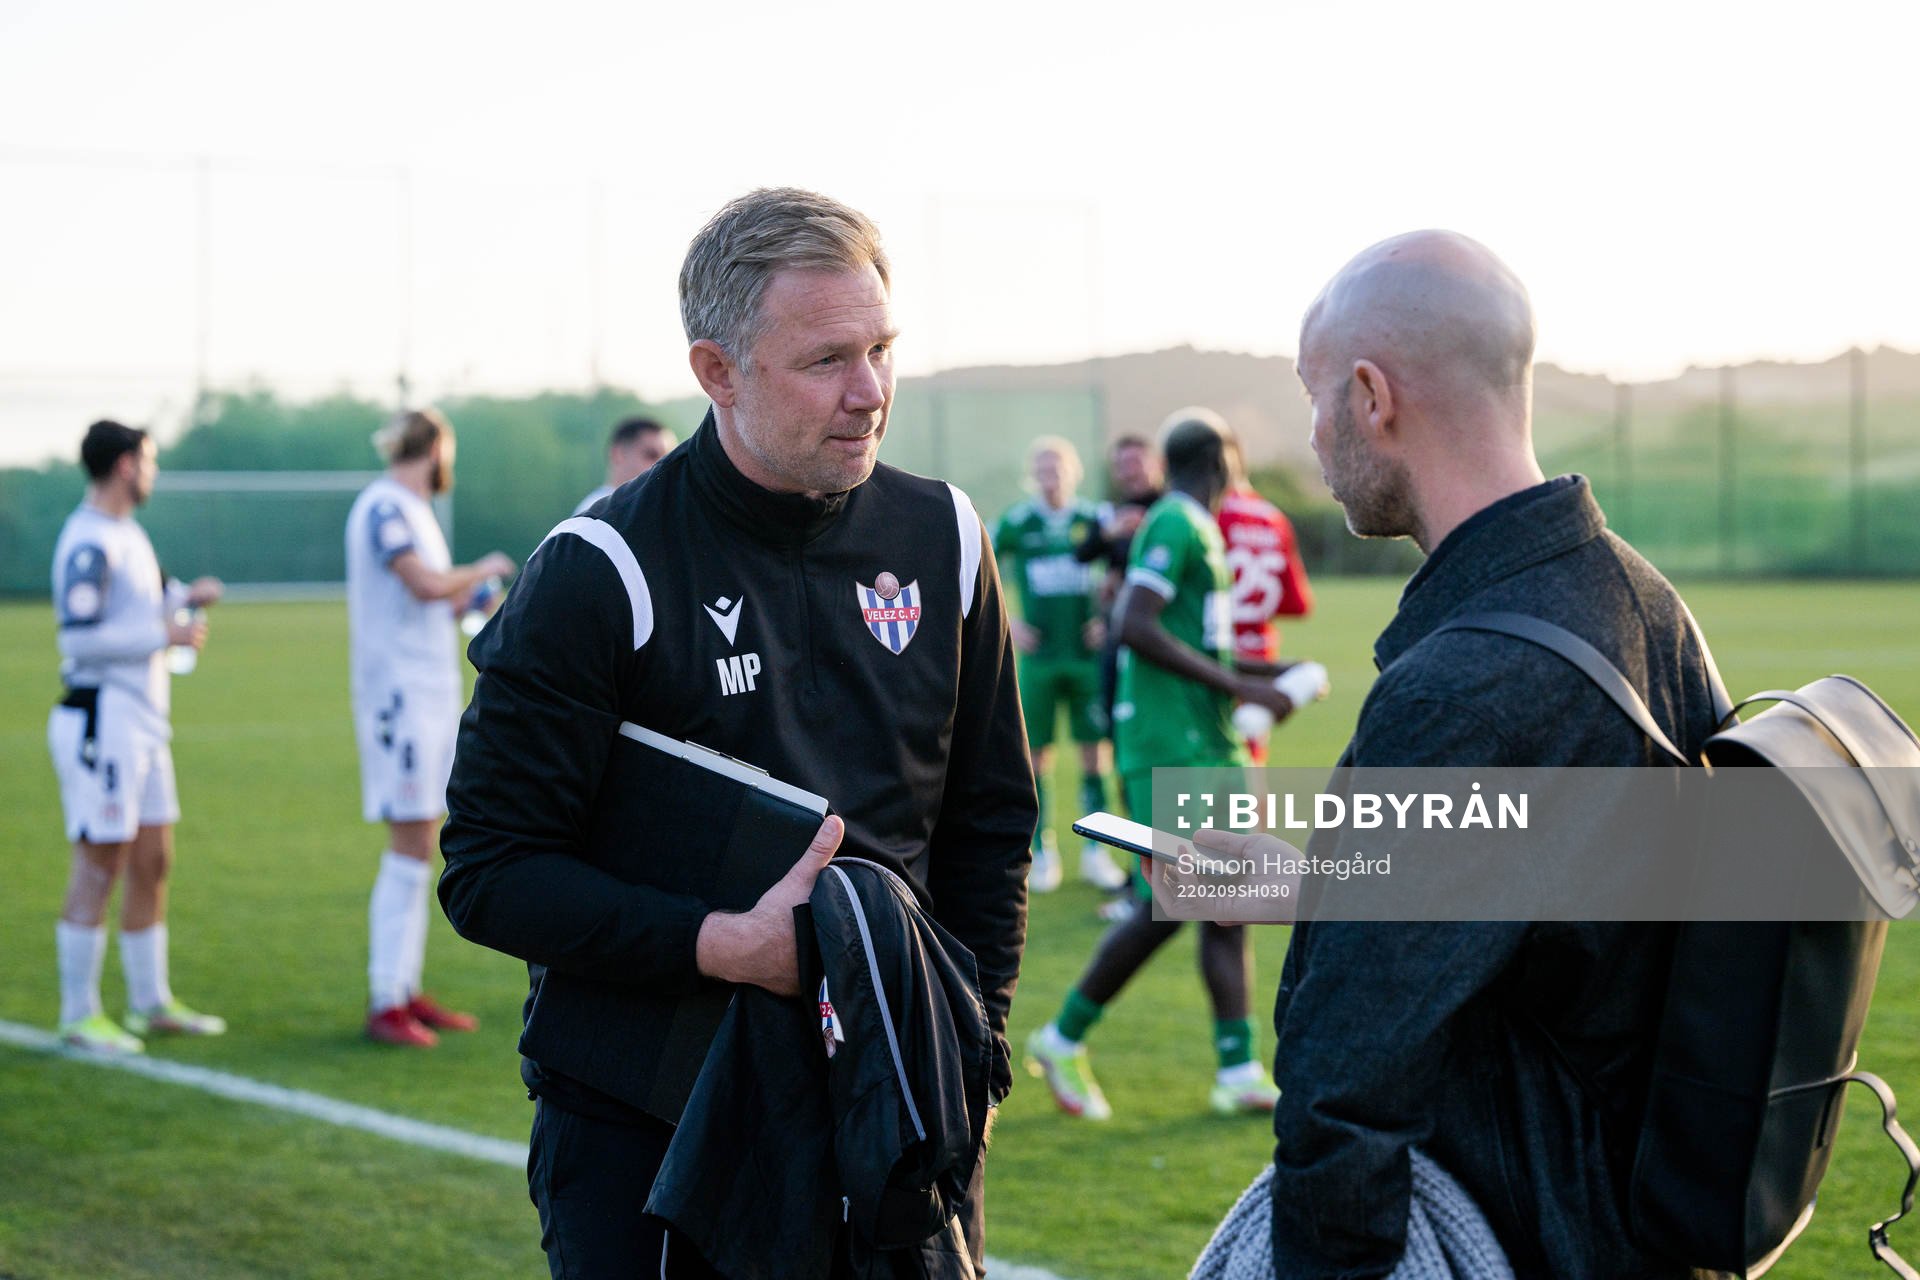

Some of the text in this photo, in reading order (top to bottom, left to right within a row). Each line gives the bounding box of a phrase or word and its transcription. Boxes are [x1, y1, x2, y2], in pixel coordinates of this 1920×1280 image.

[1228, 545, 1286, 624] 25
[867, 609, 918, 620] VELEZ C. F.
[716, 653, 761, 696] MP
